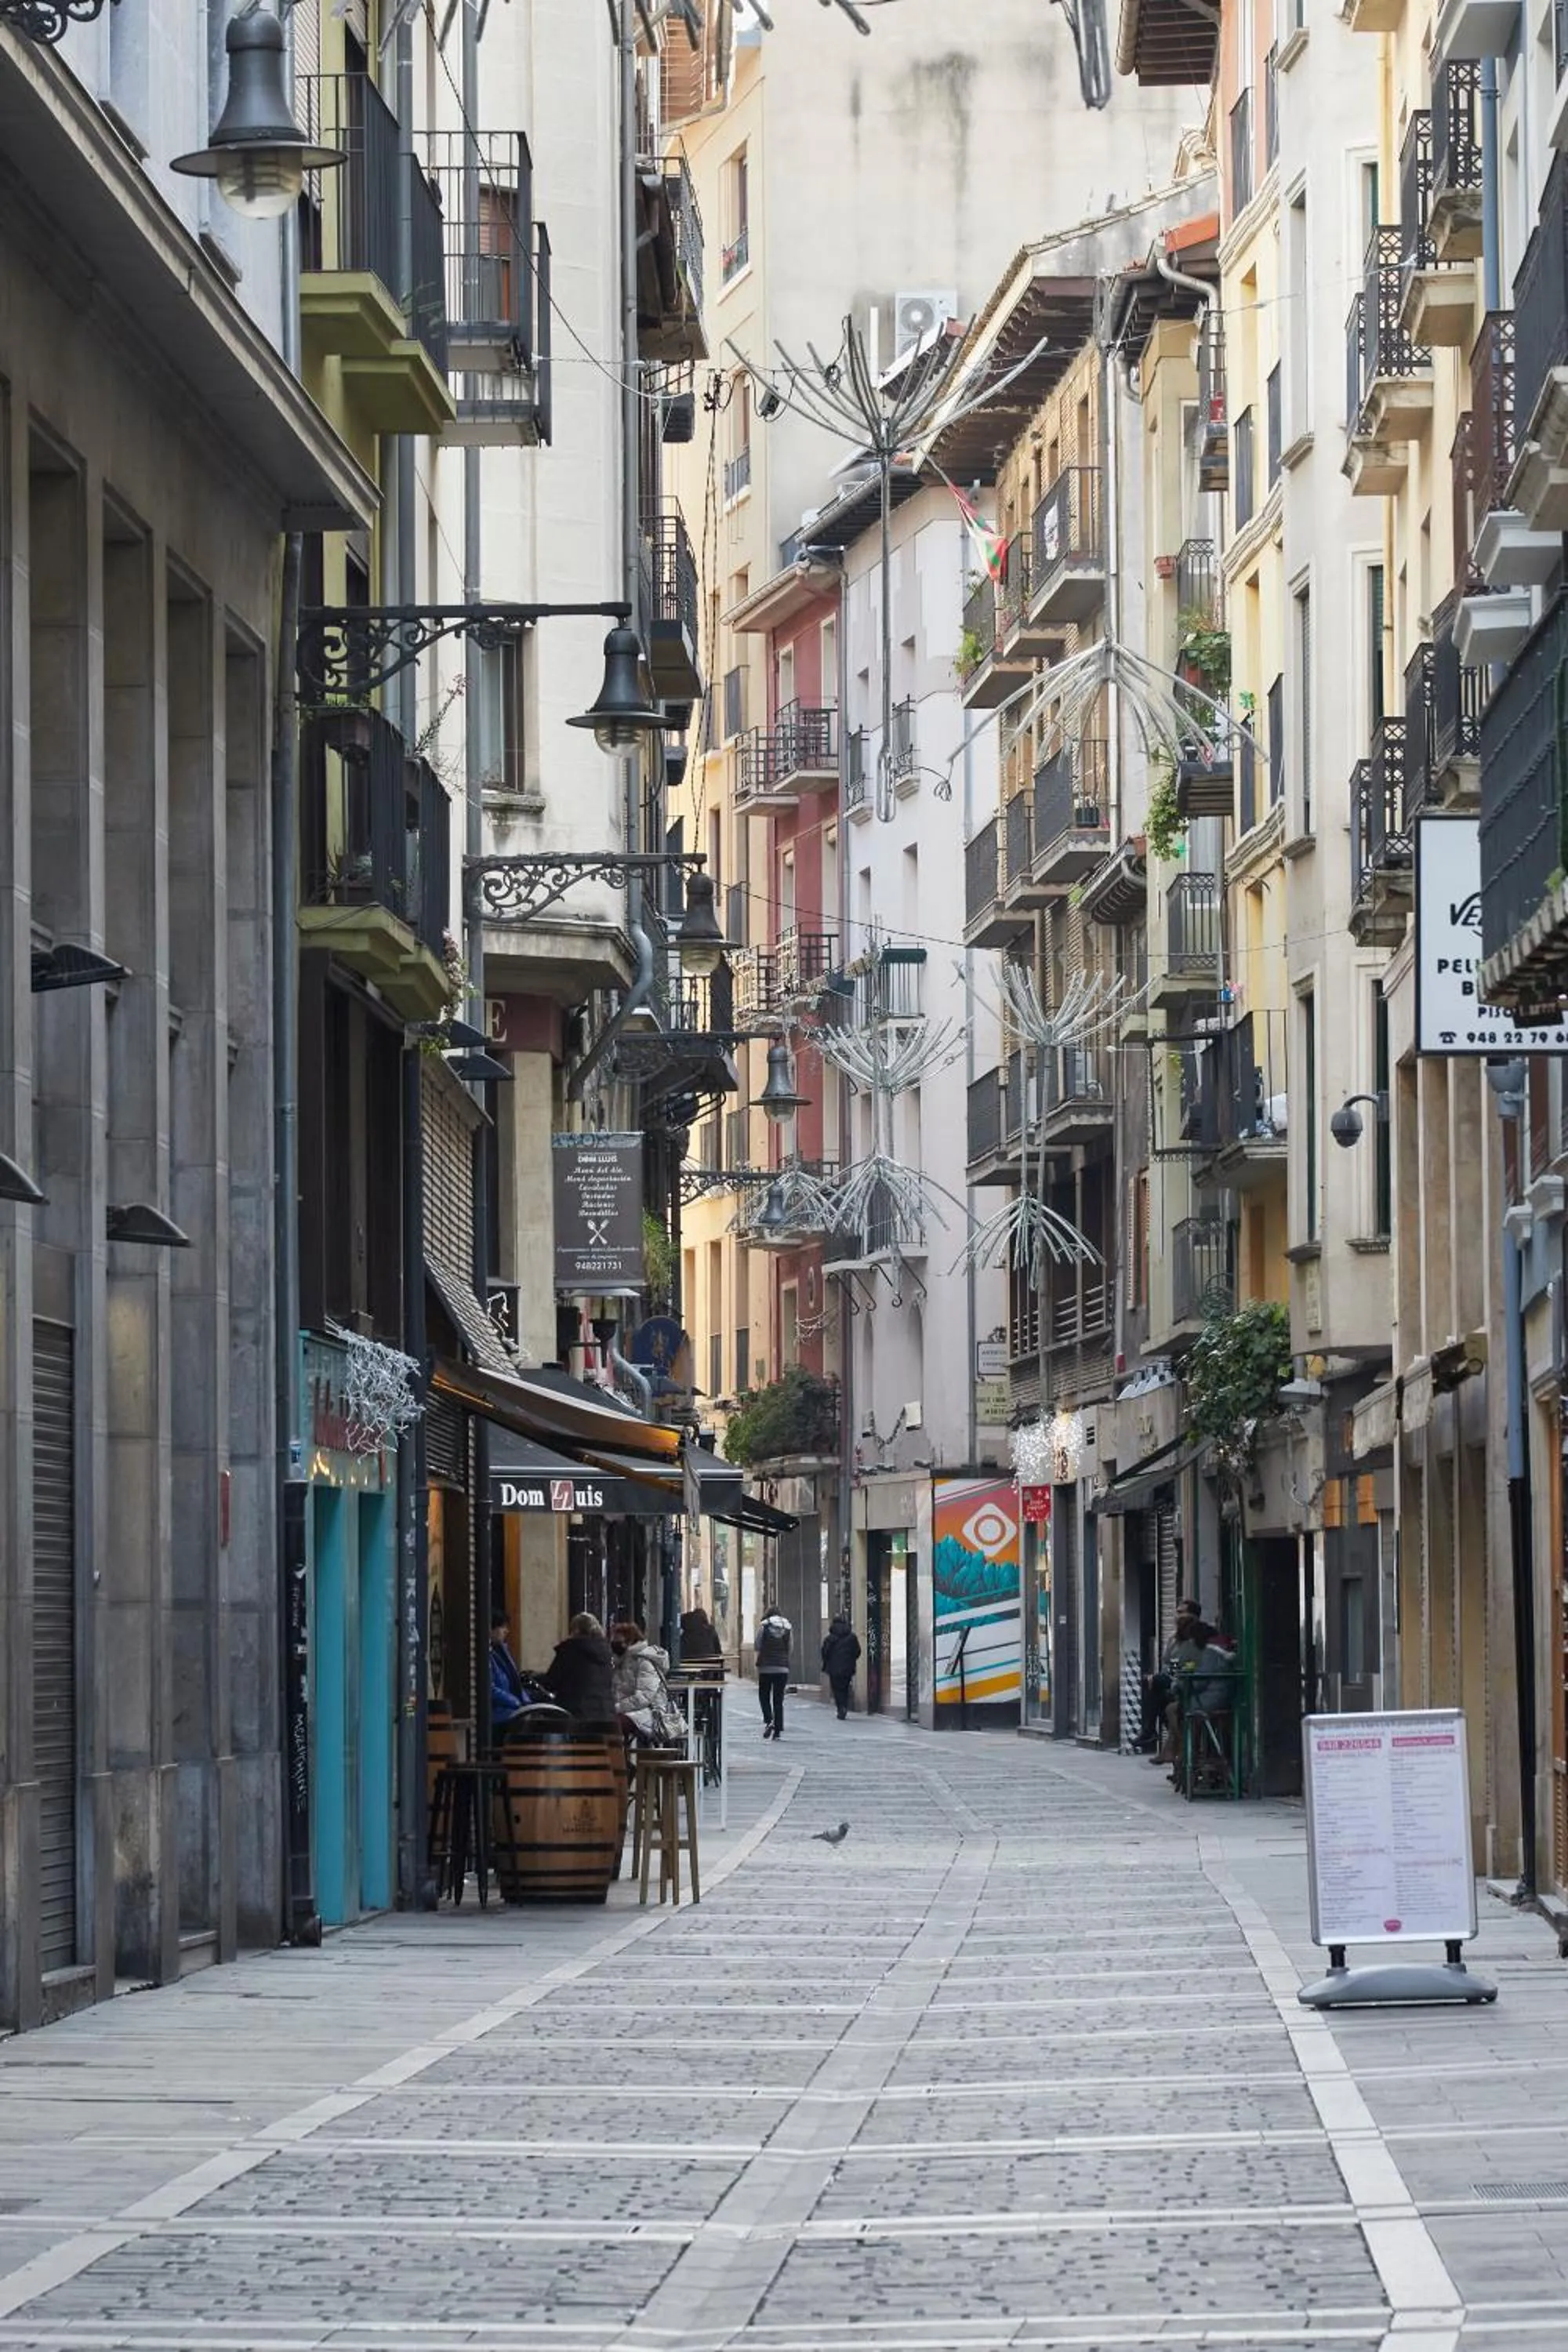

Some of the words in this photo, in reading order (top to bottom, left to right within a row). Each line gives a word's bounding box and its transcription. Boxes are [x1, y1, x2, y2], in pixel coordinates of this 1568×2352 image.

[1450, 892, 1481, 925] VE
[1467, 1032, 1497, 1044] 948
[1504, 1032, 1523, 1044] 22
[1530, 1032, 1548, 1044] 79
[500, 1483, 544, 1505] Dom
